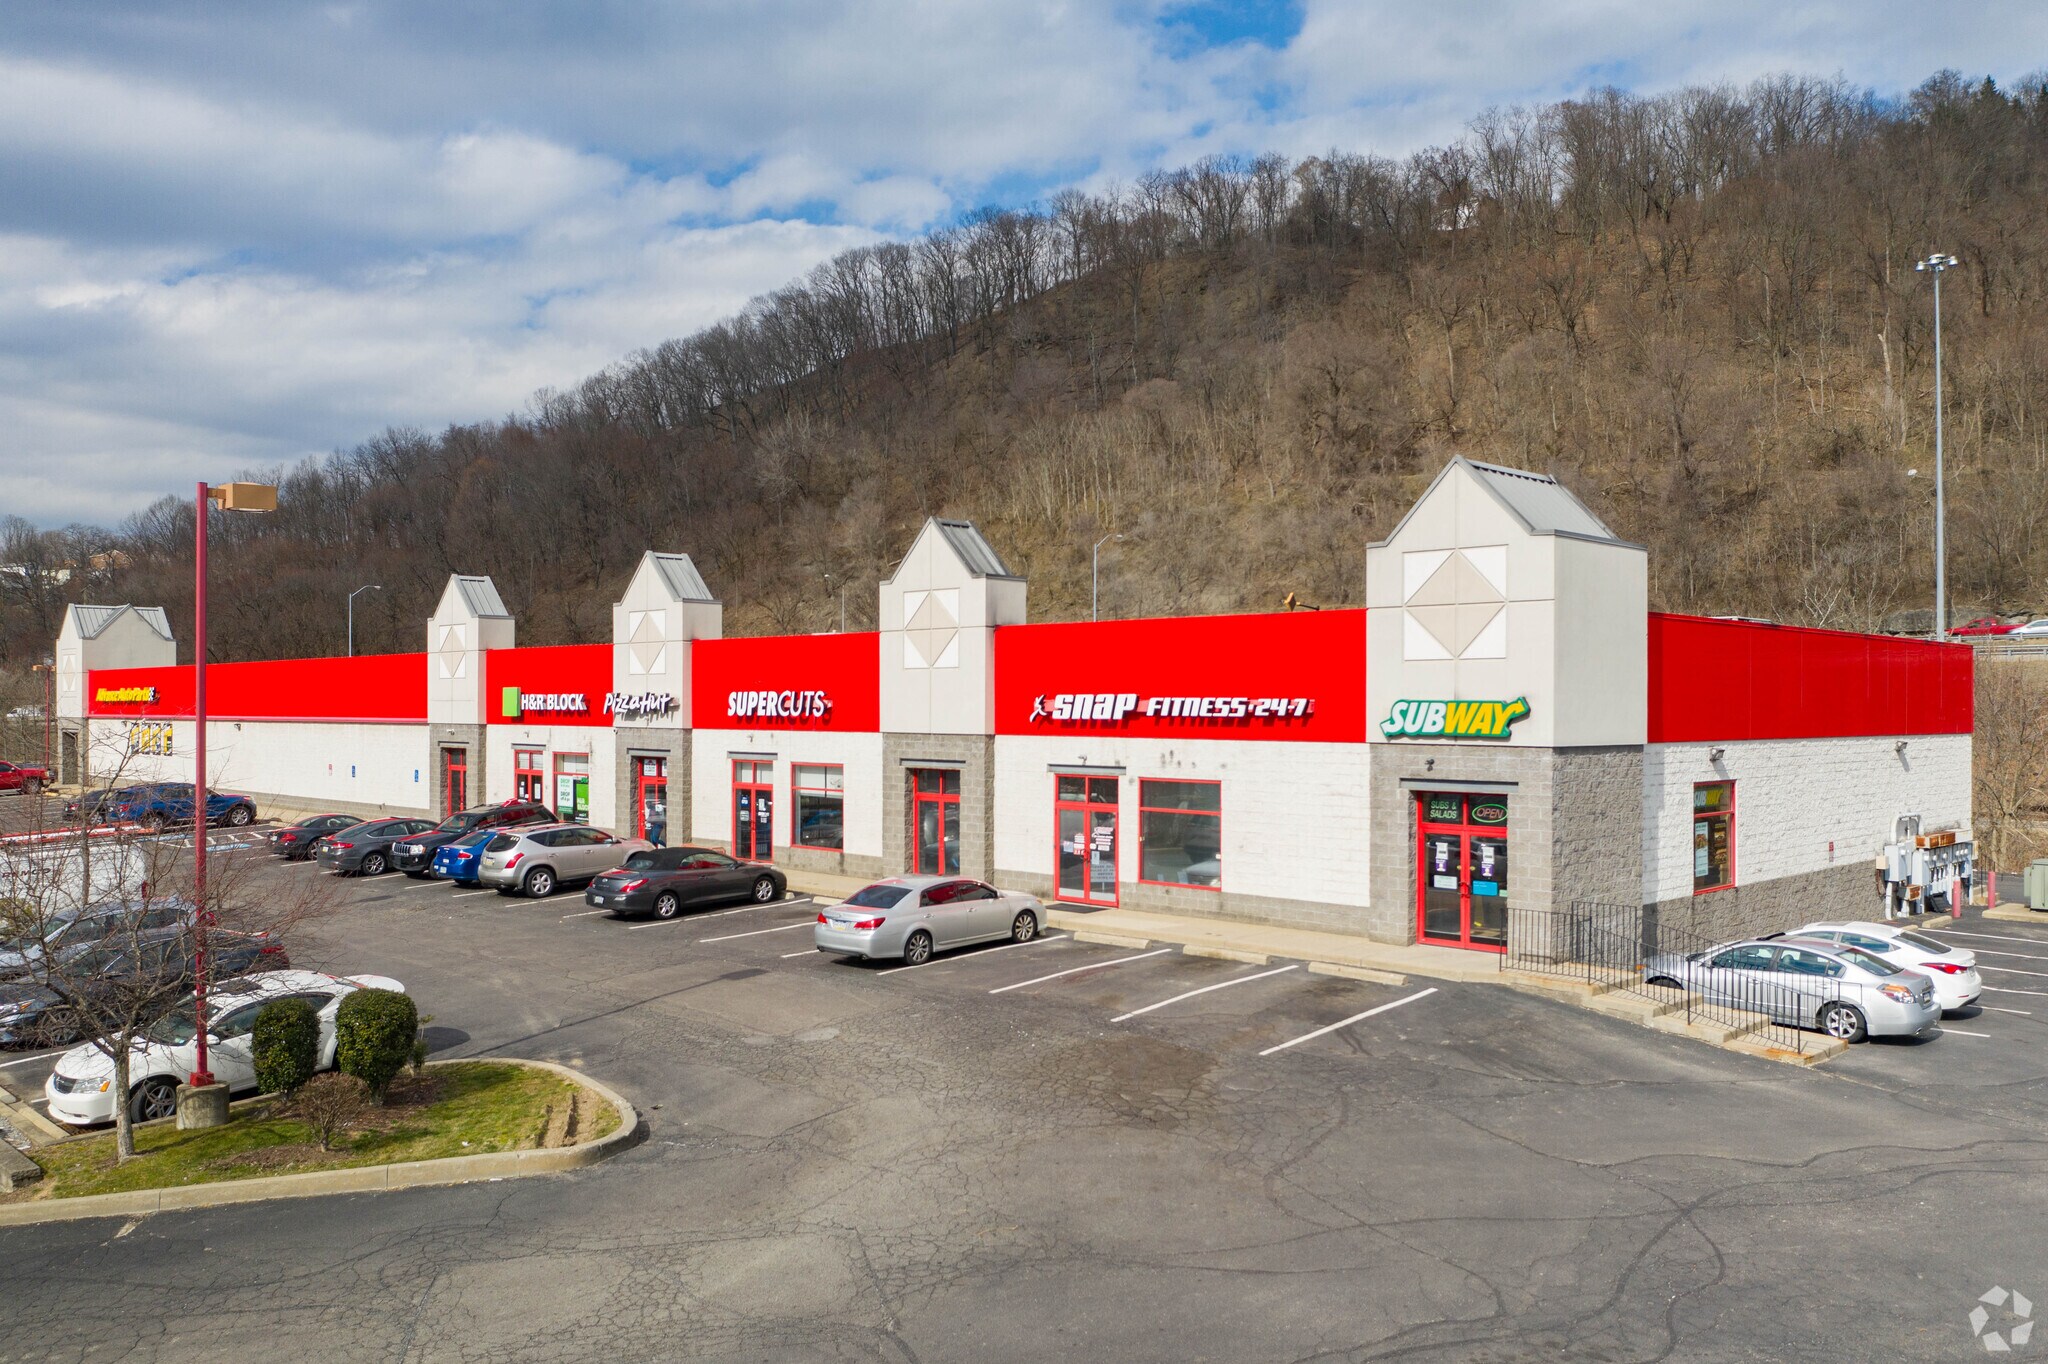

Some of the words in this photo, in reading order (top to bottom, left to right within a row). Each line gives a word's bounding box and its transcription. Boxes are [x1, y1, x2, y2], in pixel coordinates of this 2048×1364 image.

[521, 694, 545, 711] H&R
[547, 693, 585, 711] BLOCK
[603, 692, 640, 714] Pizza
[640, 691, 671, 714] Hut
[727, 690, 825, 717] SUPERCUTS
[1146, 697, 1248, 717] FITNESS
[1381, 699, 1526, 735] SUBWAY
[1430, 800, 1449, 810] SUBS
[1430, 809, 1457, 819] SALADS
[1476, 807, 1504, 819] OPEN
